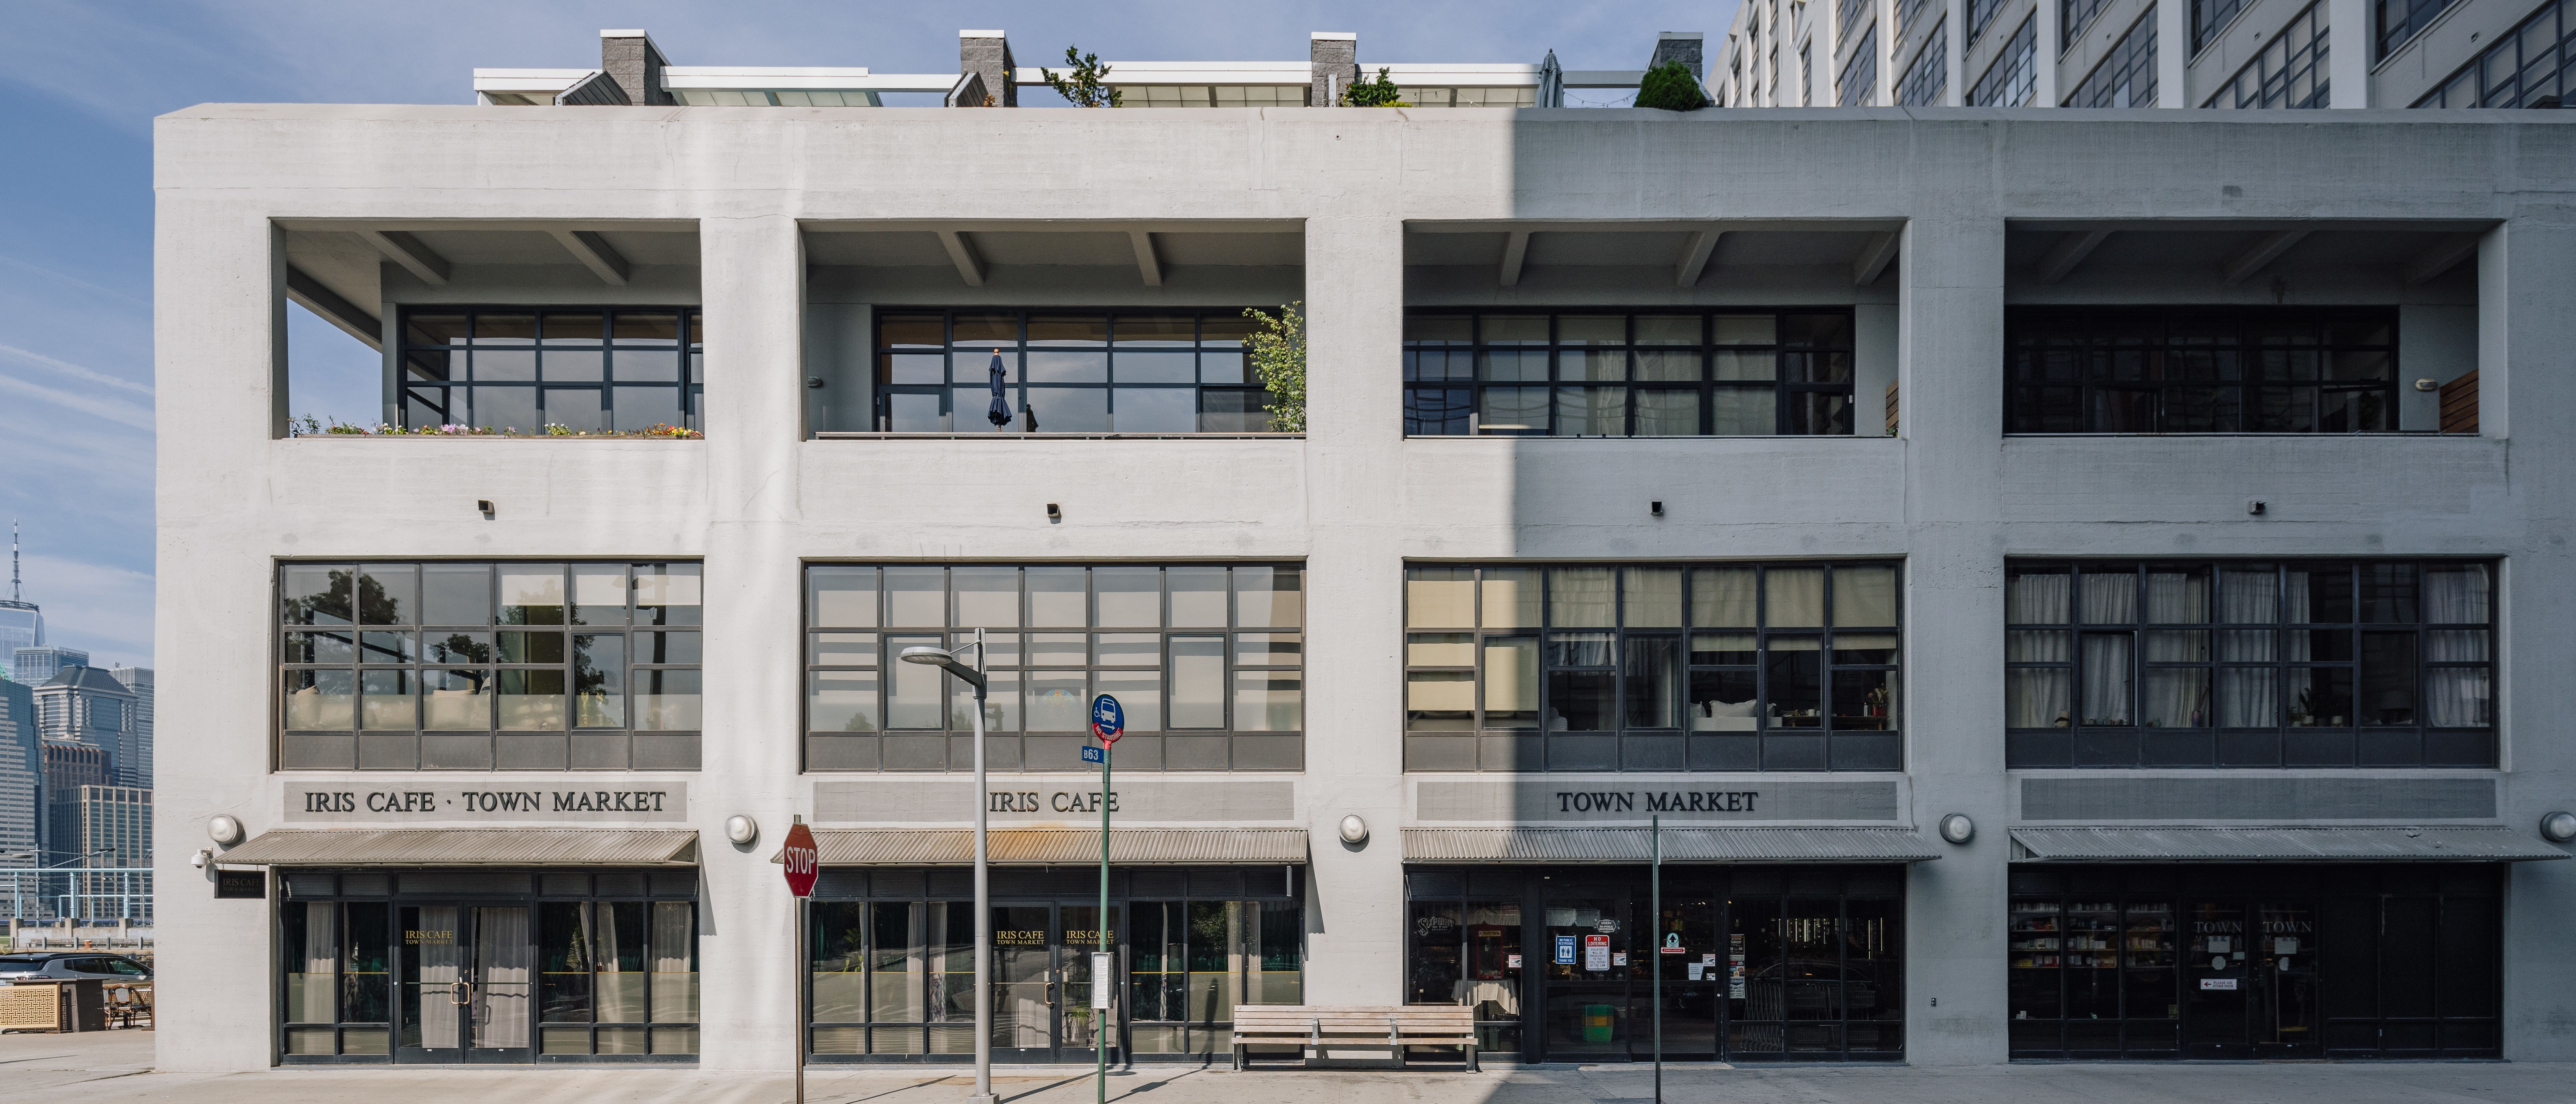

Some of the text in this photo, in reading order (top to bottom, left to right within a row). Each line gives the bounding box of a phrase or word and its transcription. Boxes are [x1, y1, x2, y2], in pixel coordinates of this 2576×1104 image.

[1095, 726, 1121, 740] NO STANDING
[1084, 749, 1098, 760] B63
[305, 792, 355, 813] IRIS
[367, 792, 436, 813] CAFE
[462, 792, 542, 812] TOWN
[552, 792, 666, 812] MARKET
[989, 792, 1119, 812] IRIS CAFE
[1557, 792, 1758, 812] TOWN MARKET
[786, 846, 815, 874] STOP
[223, 878, 262, 887] IRIS CAFE
[2194, 922, 2243, 933] TOWN
[2263, 921, 2312, 933] TOWN
[405, 931, 453, 939] IRIS CAFE
